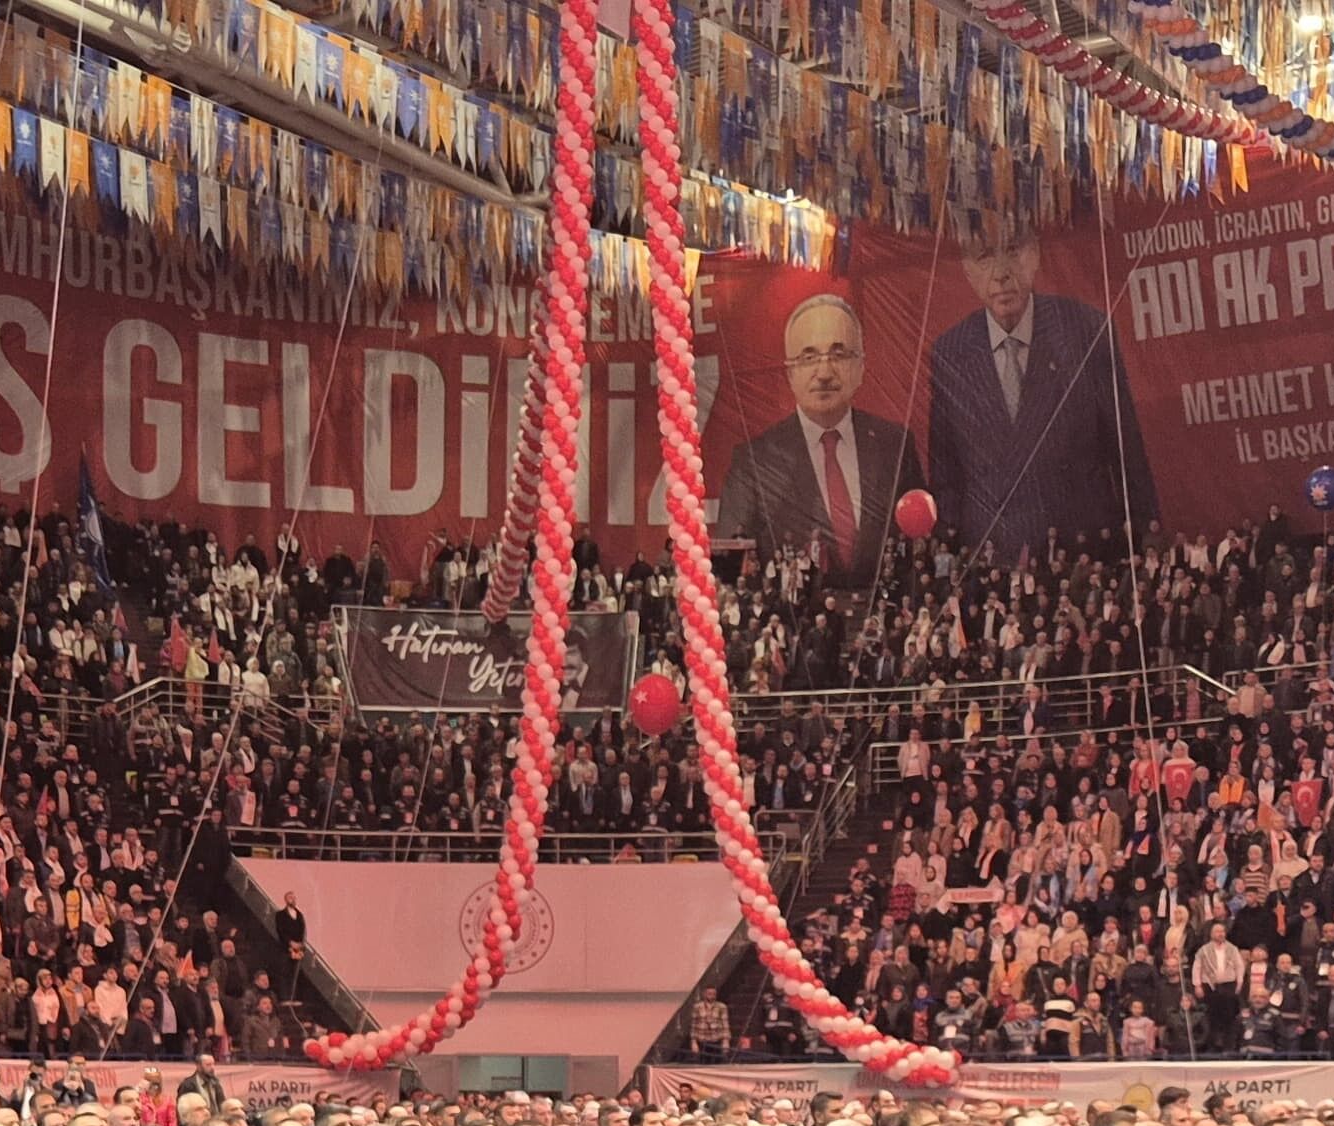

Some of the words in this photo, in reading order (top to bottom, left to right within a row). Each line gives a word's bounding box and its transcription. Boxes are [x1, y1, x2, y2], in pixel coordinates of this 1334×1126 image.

[1123, 218, 1211, 260] UMUDUN,
[1215, 200, 1312, 245] İCRAATIN,
[1128, 257, 1207, 341] ADI
[1213, 246, 1279, 329] AK
[1181, 366, 1315, 425] MEHMET
[1234, 427, 1260, 465] İL
[248, 1080, 267, 1094] AK
[1204, 1080, 1230, 1094] AK
